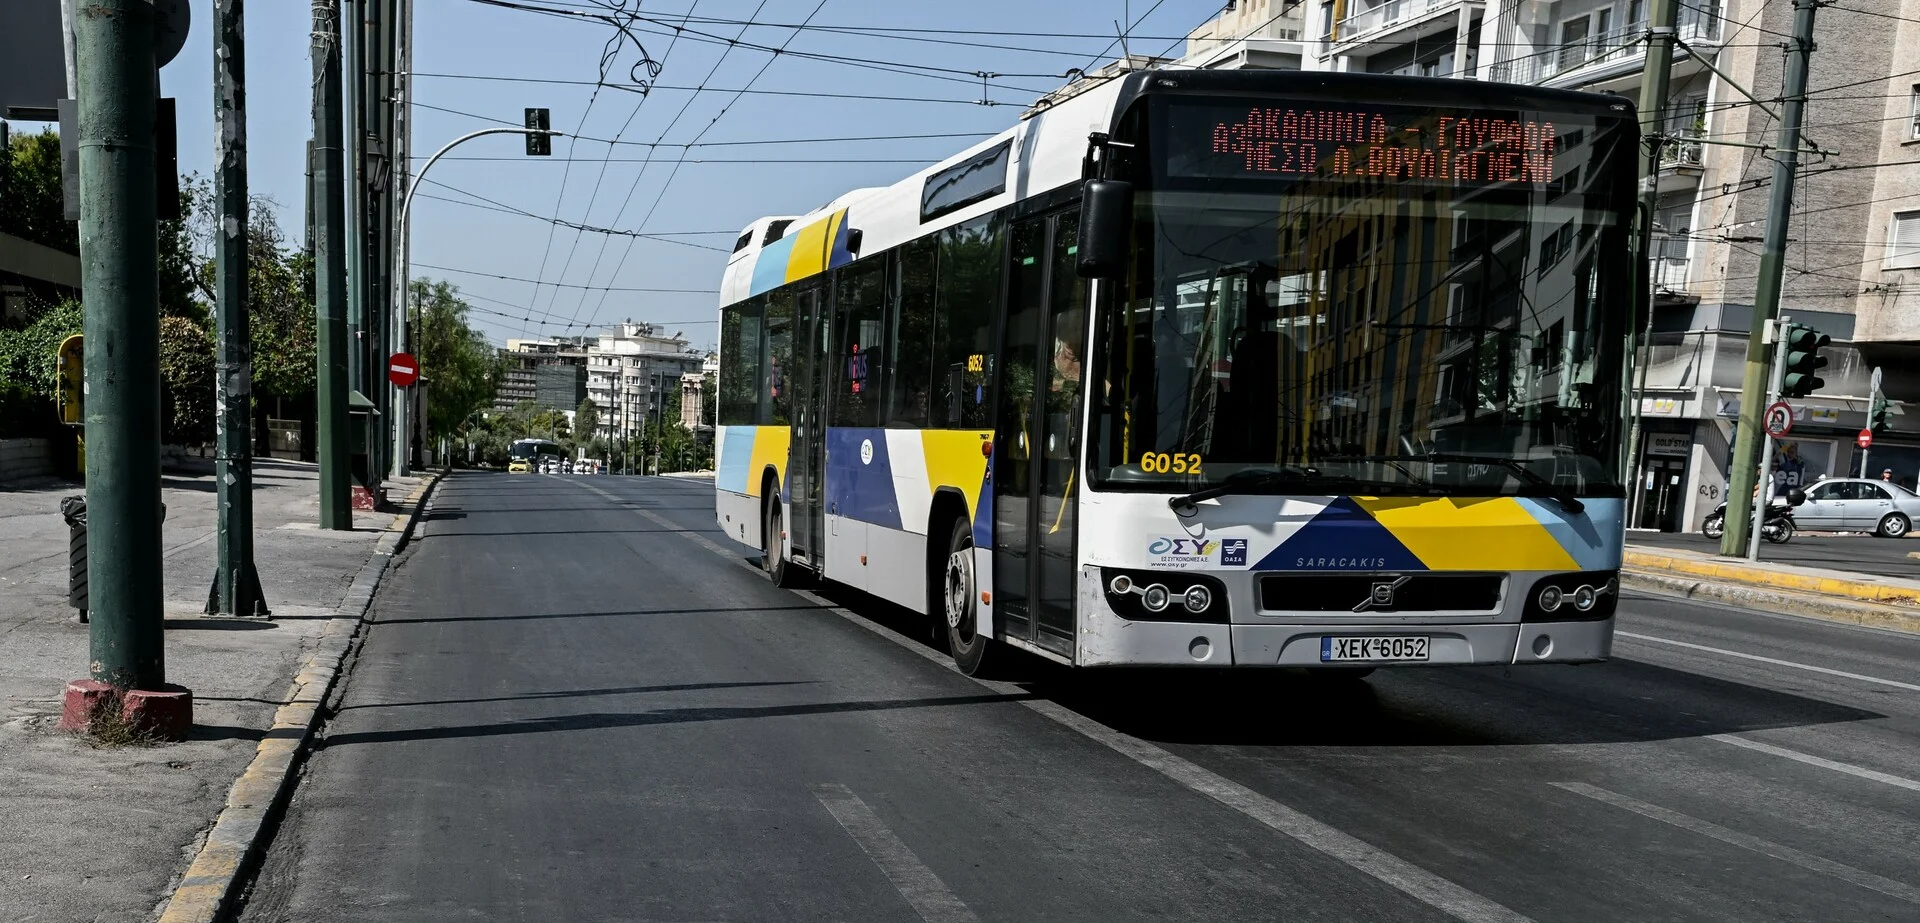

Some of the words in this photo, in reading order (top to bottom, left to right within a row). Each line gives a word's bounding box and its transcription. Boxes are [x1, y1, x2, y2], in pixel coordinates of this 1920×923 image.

[1246, 140, 1317, 173] ΜΕΣΩ
[968, 354, 983, 372] 6052
[1141, 451, 1202, 474] 6052
[1296, 557, 1385, 567] SARACAKIS
